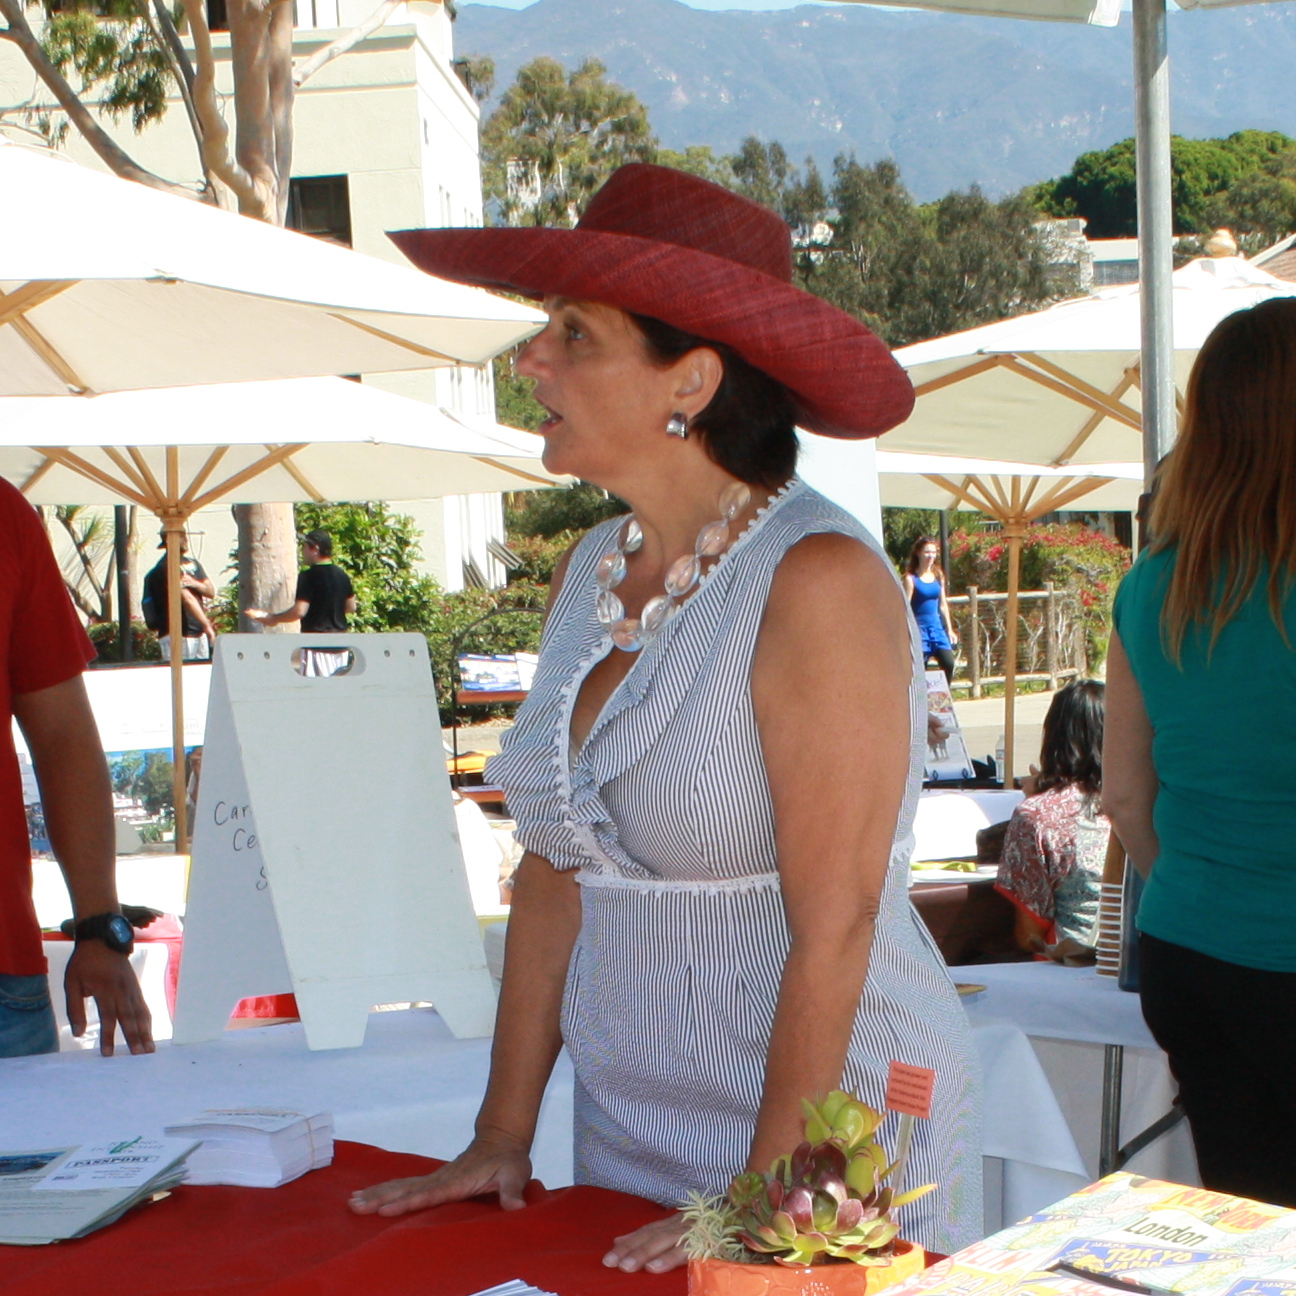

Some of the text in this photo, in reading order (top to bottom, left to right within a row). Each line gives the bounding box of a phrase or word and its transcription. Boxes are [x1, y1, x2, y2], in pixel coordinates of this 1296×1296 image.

[214, 801, 252, 826] Car
[233, 828, 260, 852] Ce
[1124, 1216, 1209, 1248] London
[1103, 1246, 1194, 1265] TOKYO
